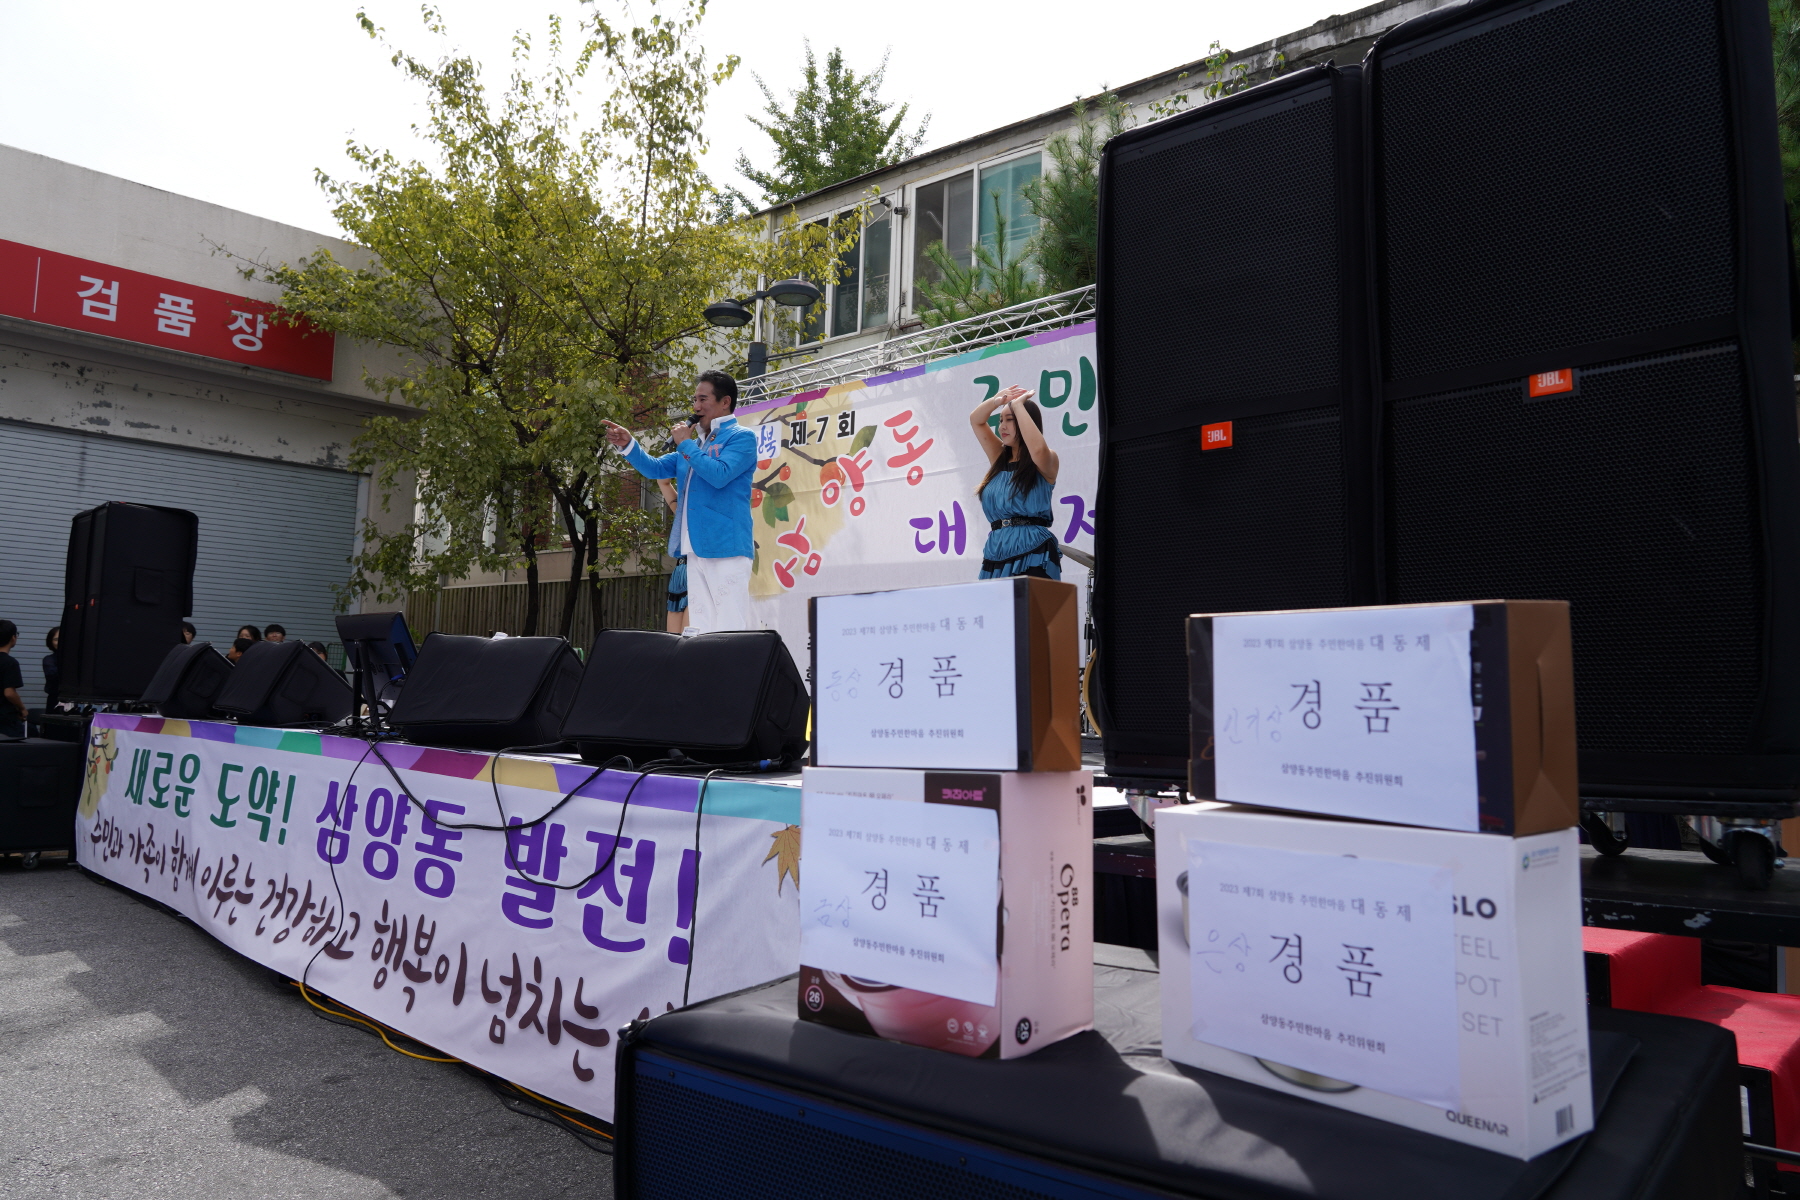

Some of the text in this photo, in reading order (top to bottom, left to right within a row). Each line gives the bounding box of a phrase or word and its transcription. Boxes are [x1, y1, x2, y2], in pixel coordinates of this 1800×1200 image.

[1537, 371, 1564, 388] JBL
[1207, 429, 1227, 443] JBL
[124, 748, 201, 818] 새로운
[210, 763, 297, 846] 도약!
[315, 780, 467, 900] 삼양동
[1056, 863, 1075, 952] Opera
[809, 991, 820, 1003] 26
[481, 952, 610, 1082] 넘치는
[1462, 1011, 1503, 1037] SET
[1020, 1021, 1030, 1040] 26
